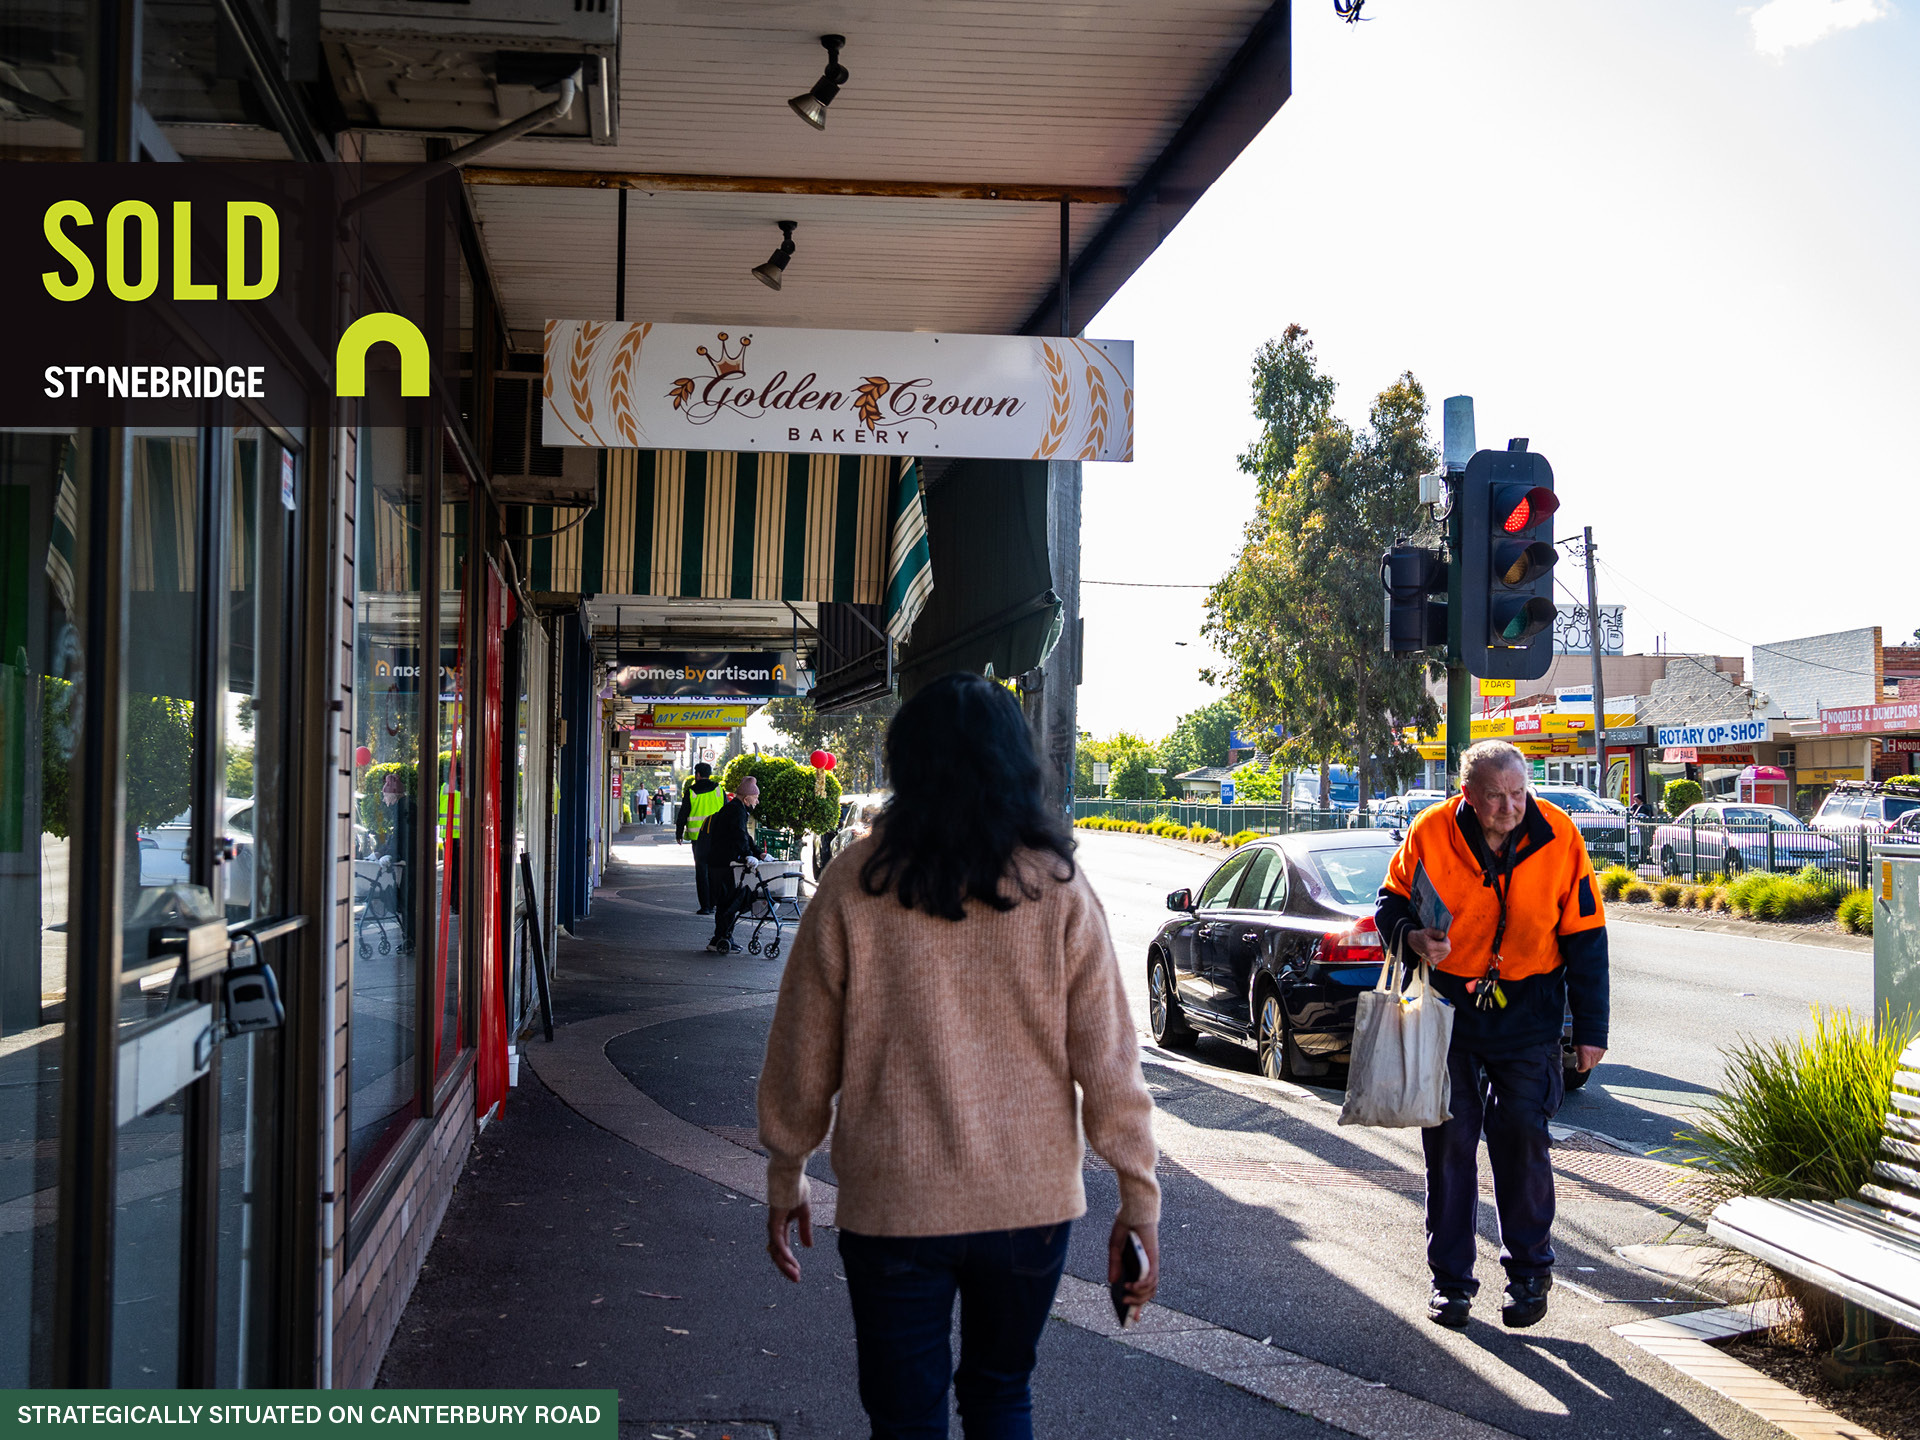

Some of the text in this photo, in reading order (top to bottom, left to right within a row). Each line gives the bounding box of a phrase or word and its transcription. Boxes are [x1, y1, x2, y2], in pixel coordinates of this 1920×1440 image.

[692, 370, 1027, 425] Golden Crown
[788, 428, 909, 444] BAKERY
[626, 665, 769, 683] homesbyartisan
[1484, 680, 1511, 689] 7 DAYS
[656, 712, 679, 724] MY
[681, 709, 725, 721] SHIRT
[722, 715, 745, 725] shop
[1864, 708, 1871, 721] &
[1872, 705, 1918, 721] DUMPLINGS
[1659, 728, 1704, 745] ROTARY
[1680, 750, 1694, 759] SALE
[1721, 755, 1749, 763] SALE
